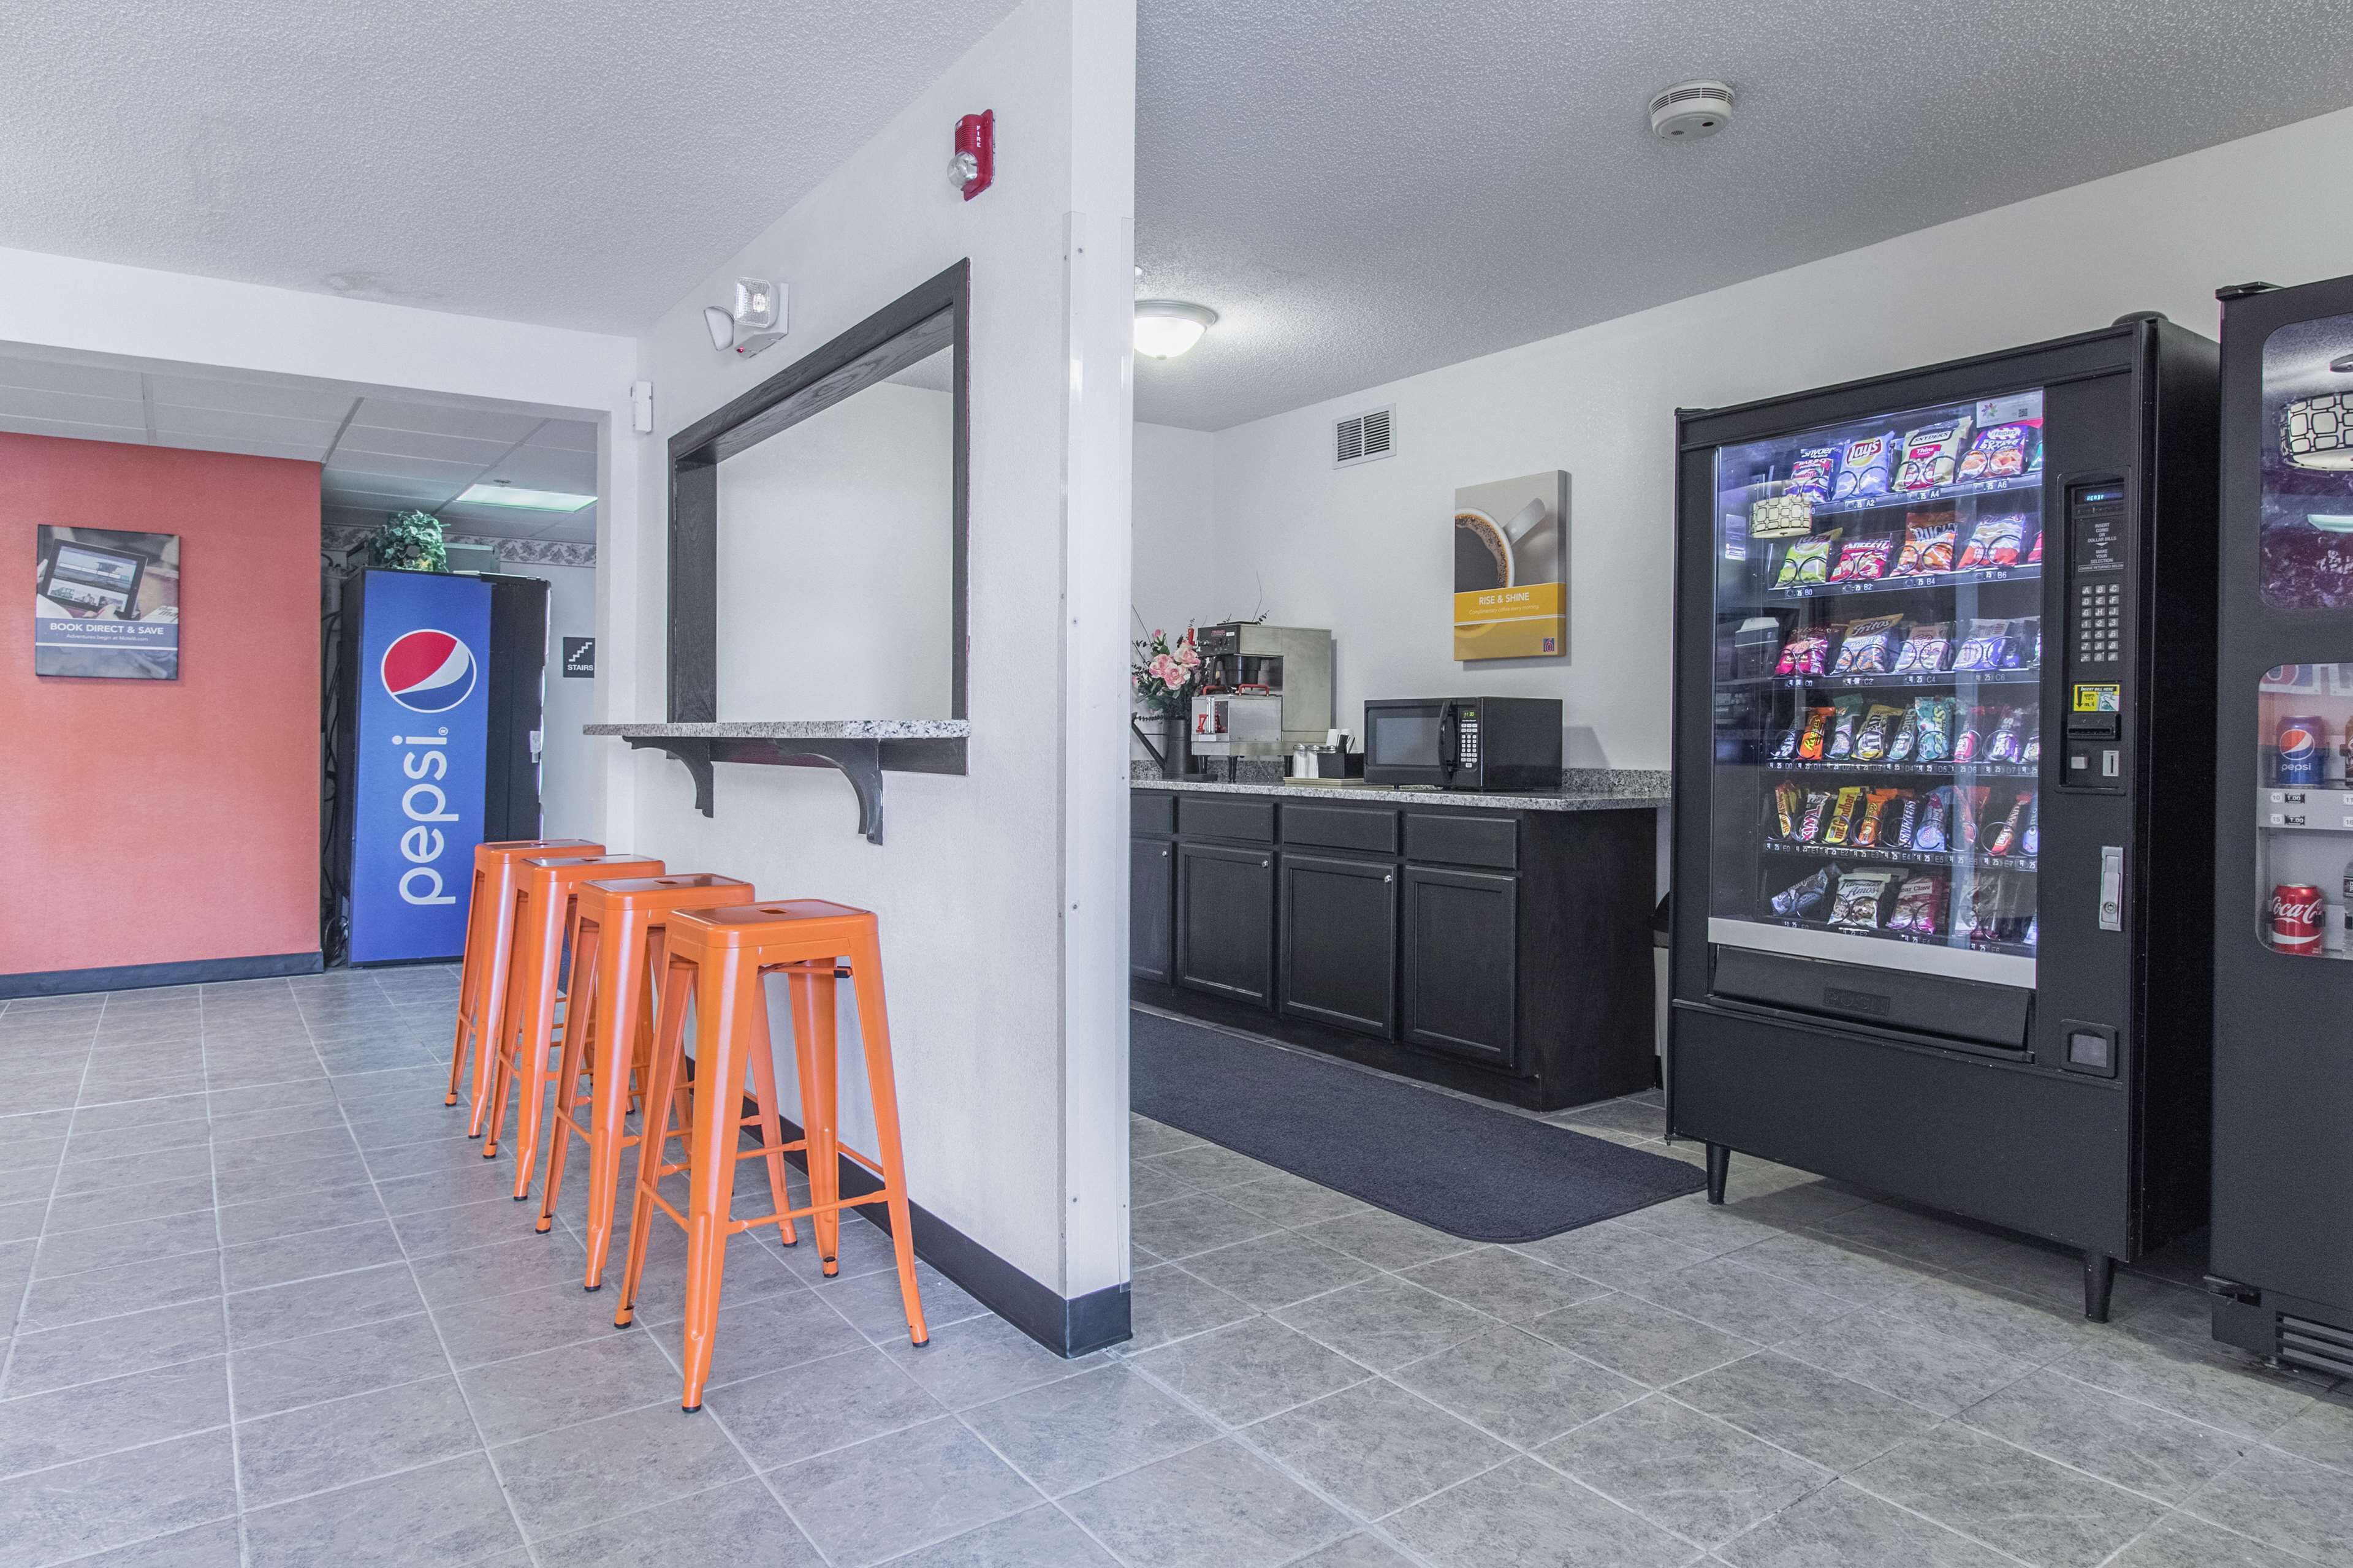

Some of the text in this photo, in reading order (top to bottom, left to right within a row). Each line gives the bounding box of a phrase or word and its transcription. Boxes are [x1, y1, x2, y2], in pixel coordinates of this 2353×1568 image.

[1479, 592, 1530, 605] RISE & SHINE
[50, 623, 164, 635] BOOK DIRECT & SAVE
[1852, 619, 1890, 636] Fritos
[1804, 714, 1821, 751] Reese's
[2281, 763, 2311, 772] pepsi
[392, 735, 459, 906] pepsi
[1845, 886, 1876, 898] Amos
